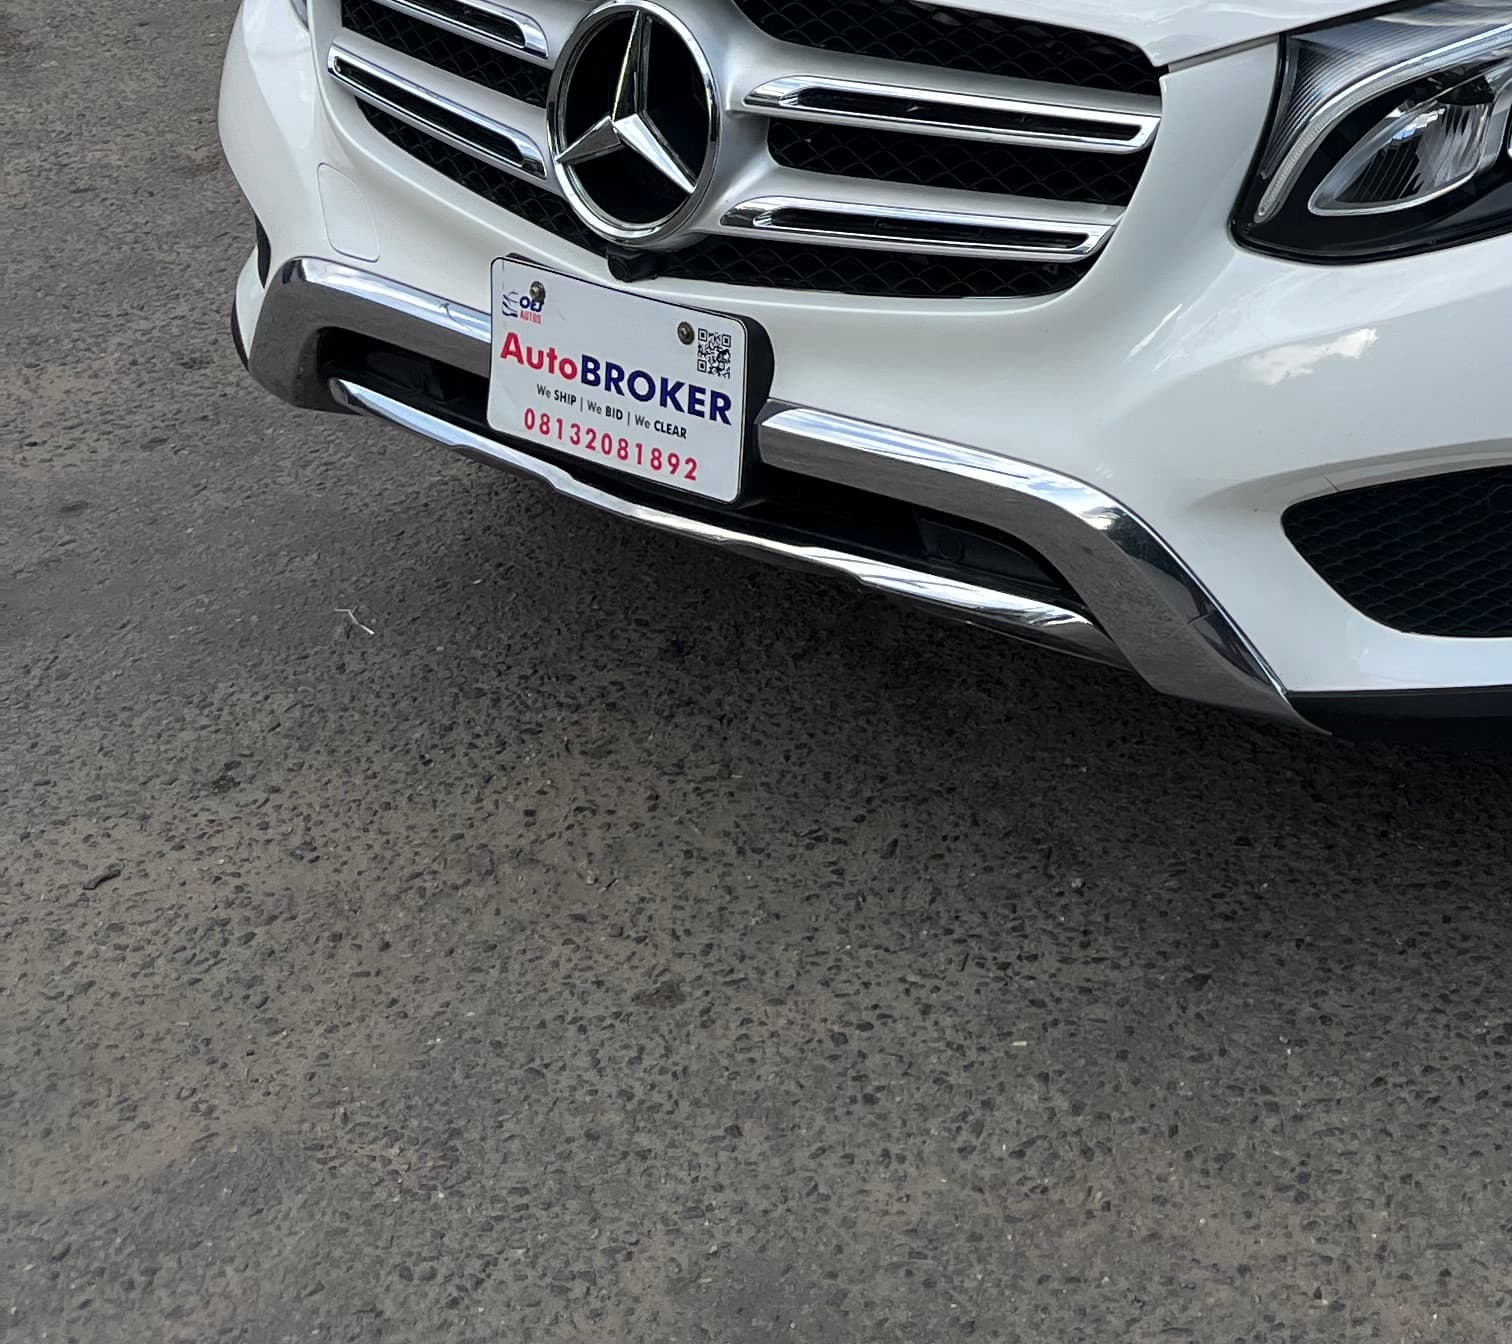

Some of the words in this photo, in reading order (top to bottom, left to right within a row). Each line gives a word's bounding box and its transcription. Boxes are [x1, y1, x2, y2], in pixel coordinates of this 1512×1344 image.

[499, 331, 732, 426] AutoBROKER
[536, 383, 552, 399] We
[553, 389, 577, 407] SHIP
[586, 399, 602, 415] We
[605, 405, 624, 421] BID
[634, 413, 651, 430] We
[653, 420, 688, 440] CLEAR
[523, 407, 698, 482] 08132081892
